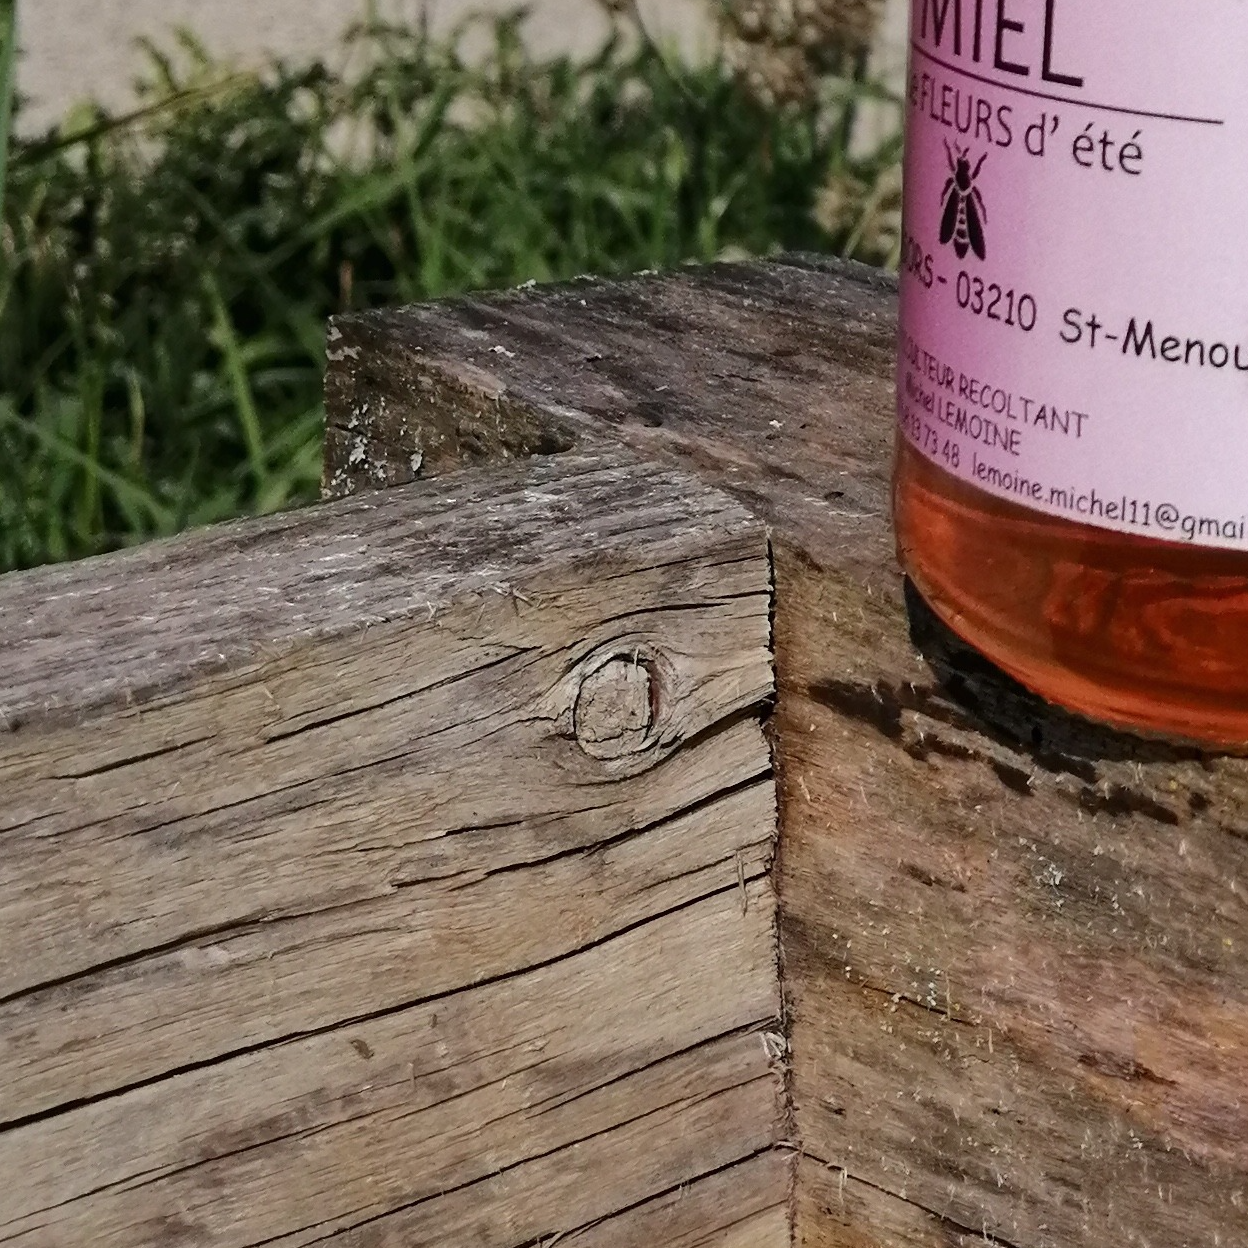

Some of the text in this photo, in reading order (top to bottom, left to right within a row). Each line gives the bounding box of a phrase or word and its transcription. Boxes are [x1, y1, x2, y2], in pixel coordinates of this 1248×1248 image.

[920, 73, 1013, 148] FLEURS
[1072, 122, 1144, 176] été
[956, 270, 1037, 332] 03210
[938, 397, 1022, 456] LEMOINE
[960, 372, 1089, 439] RECOLTANT
[941, 439, 960, 469] 48
